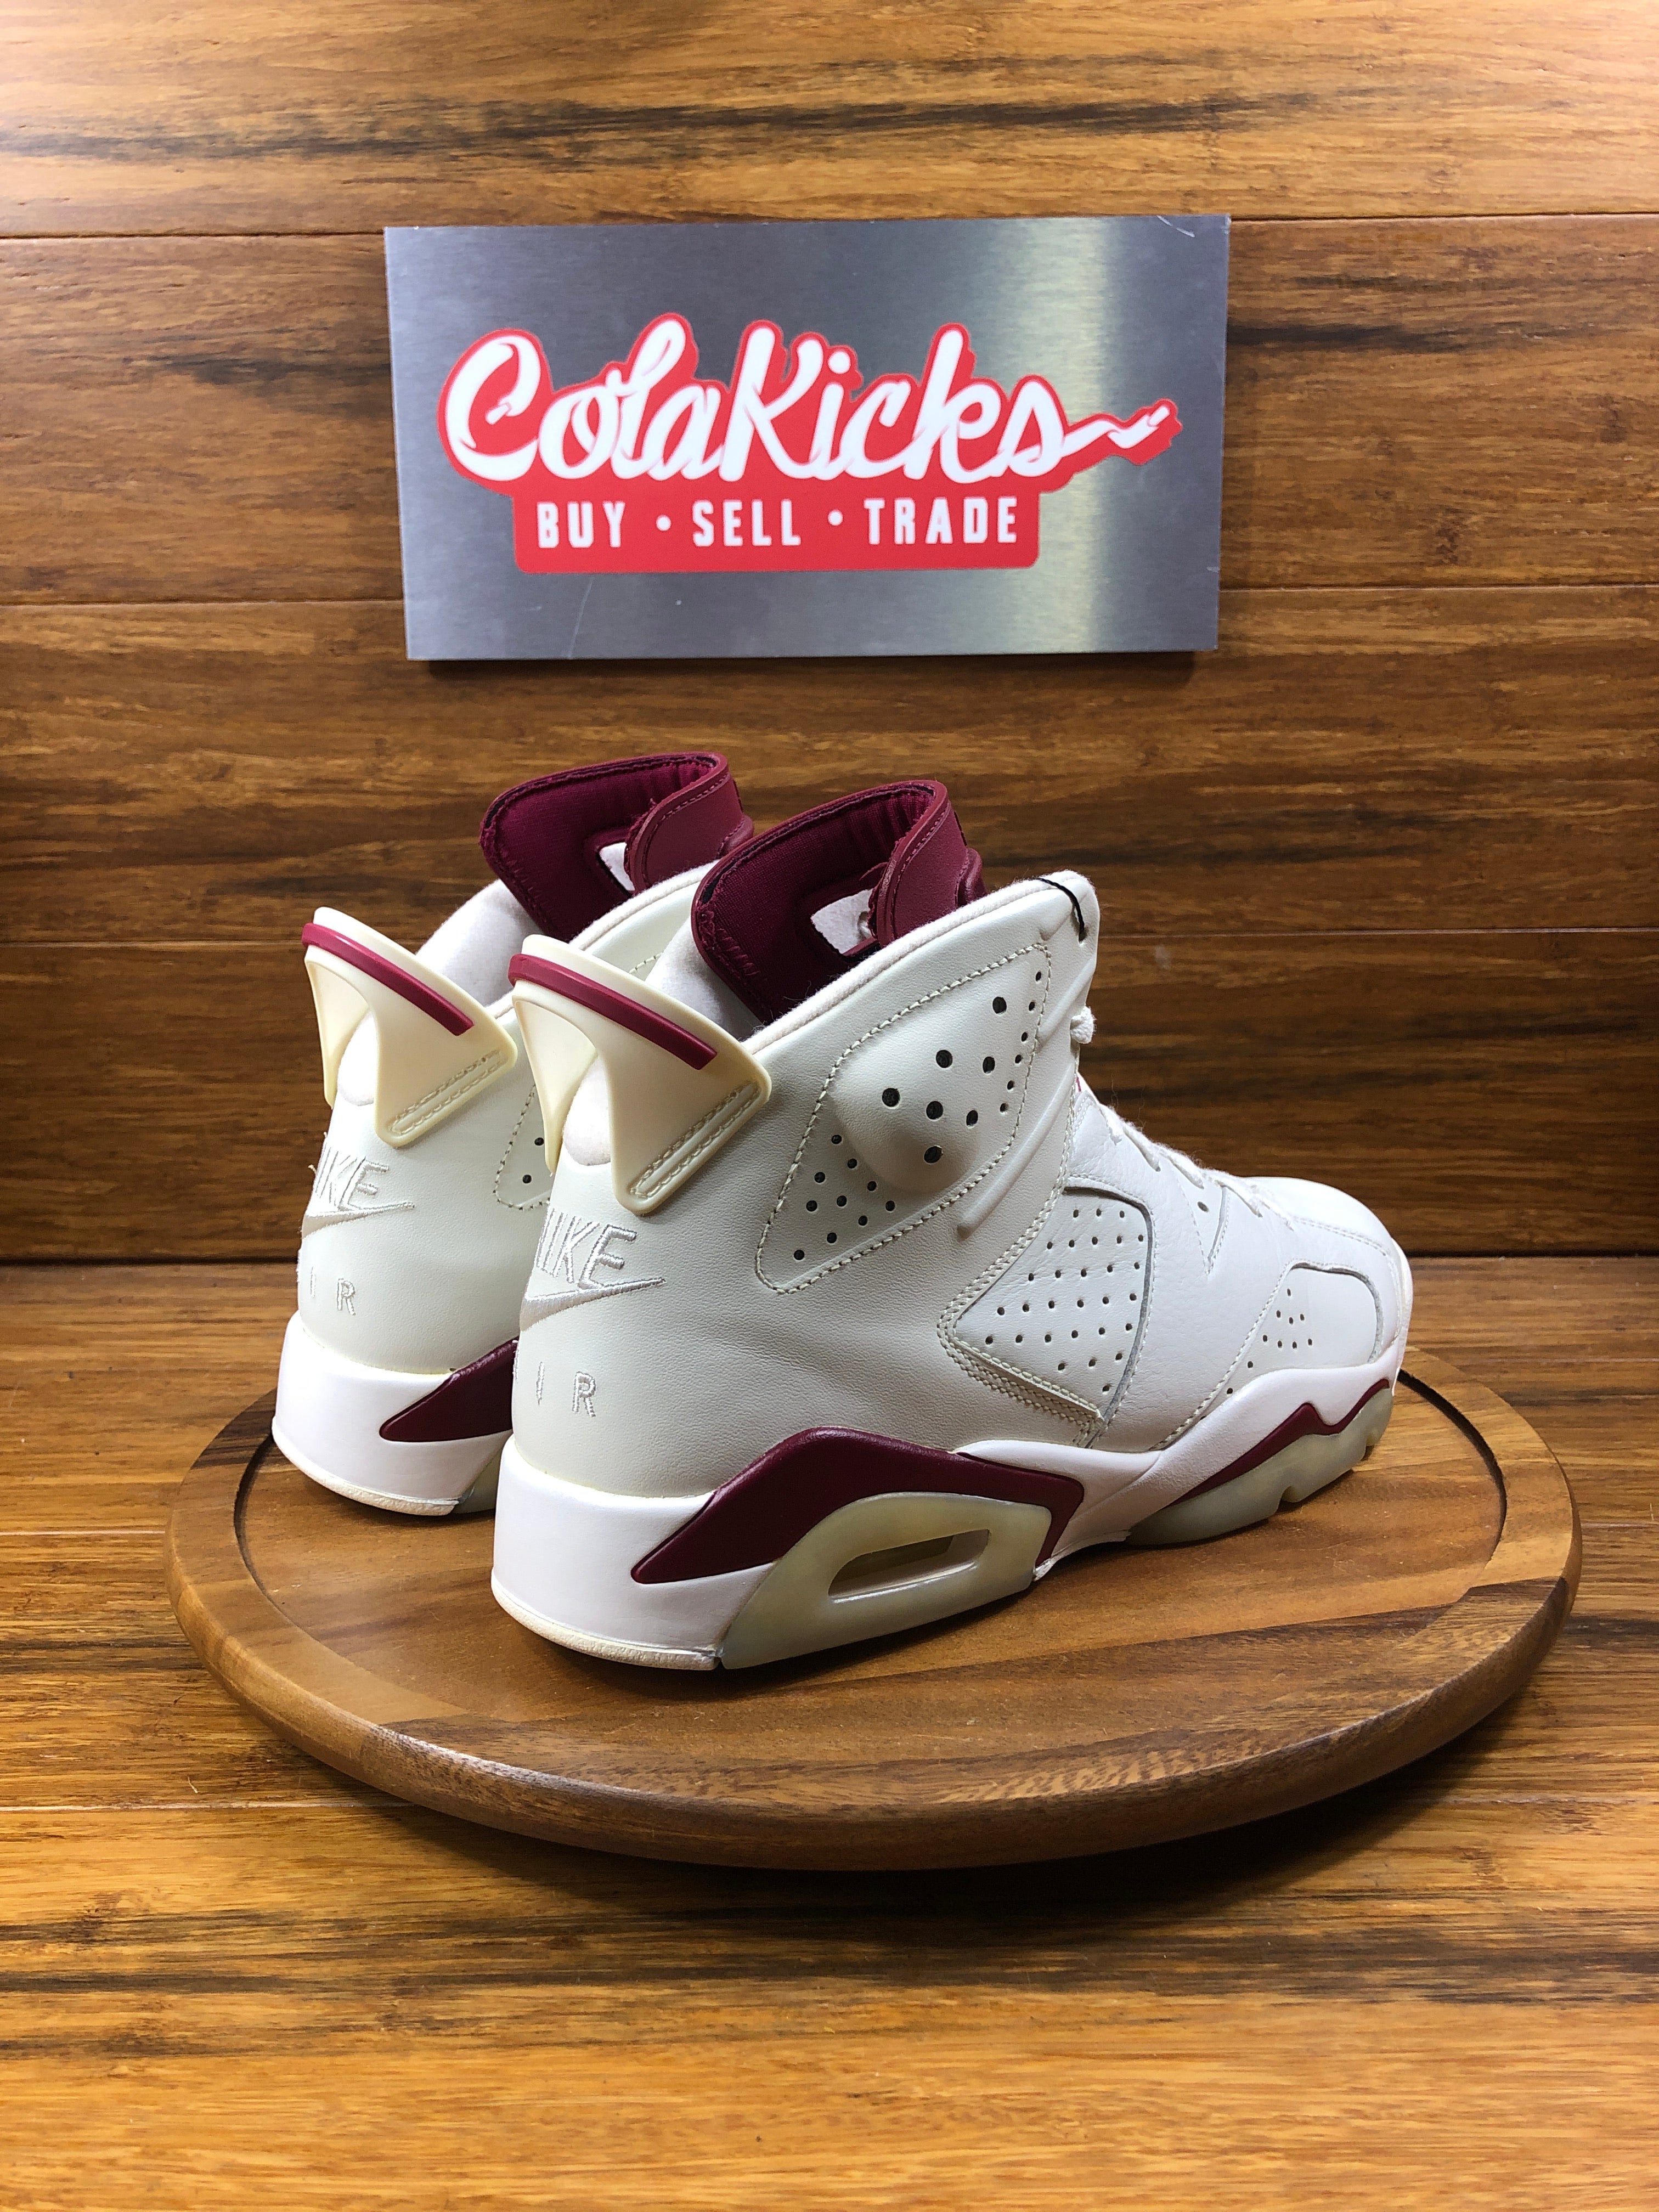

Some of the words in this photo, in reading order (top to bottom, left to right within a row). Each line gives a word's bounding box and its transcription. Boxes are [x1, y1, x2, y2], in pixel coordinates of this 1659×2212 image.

[537, 501, 625, 548] BUY
[692, 499, 802, 547] SELL
[864, 497, 1017, 544] TRADE
[535, 1207, 639, 1290] IKE
[517, 1356, 596, 1417] IR
